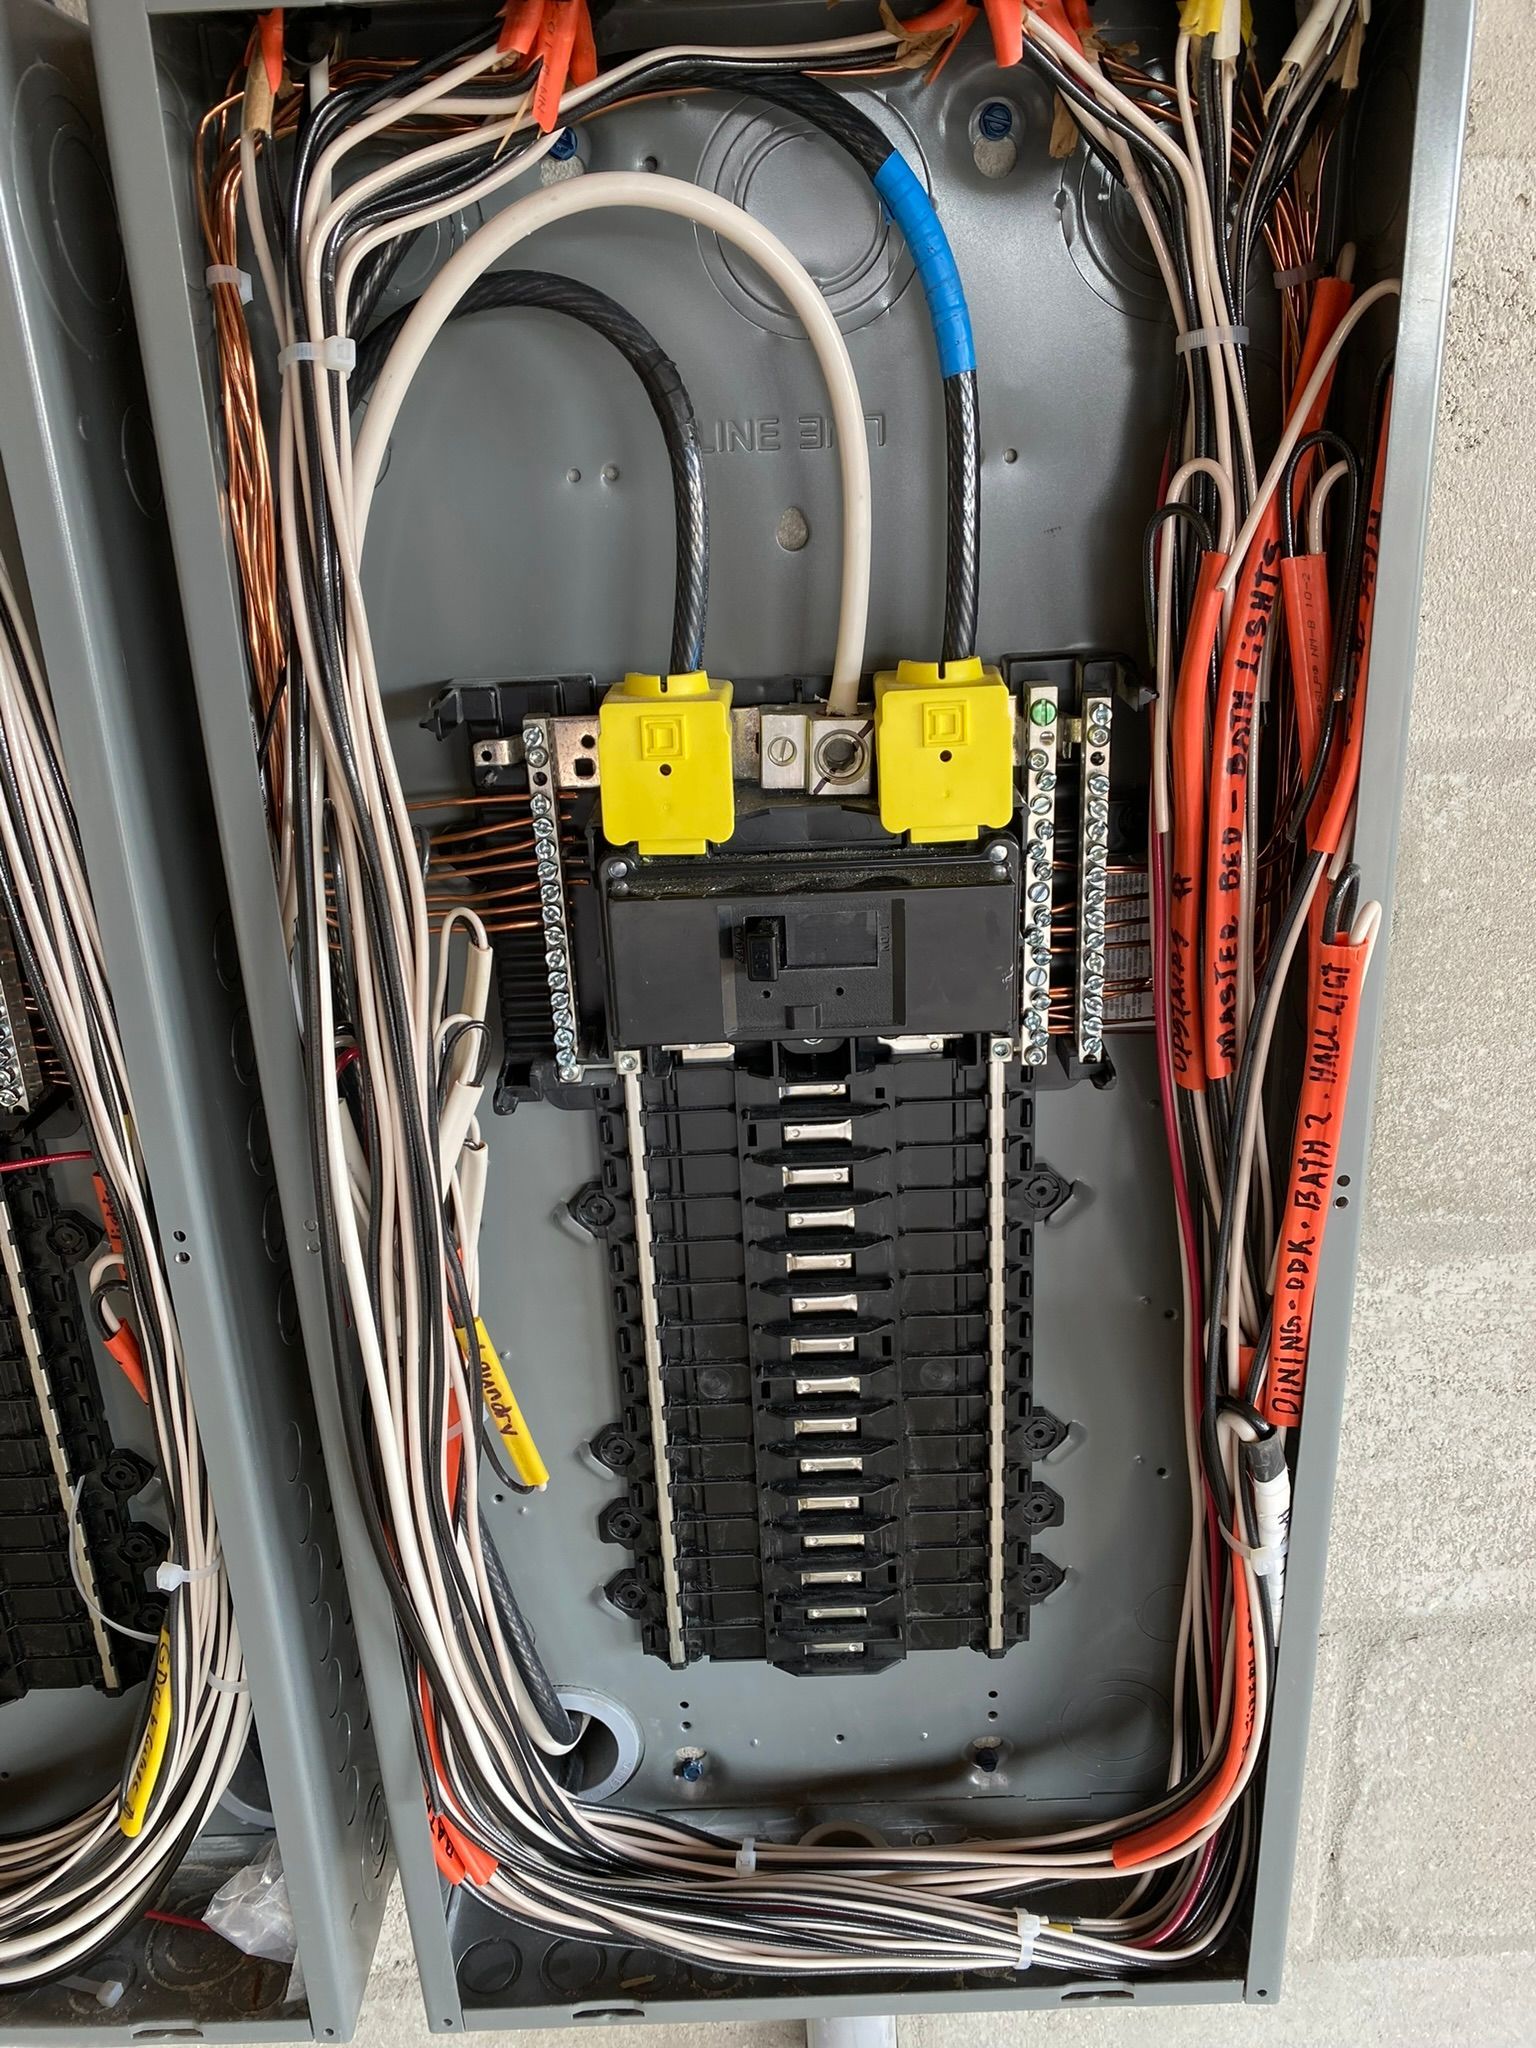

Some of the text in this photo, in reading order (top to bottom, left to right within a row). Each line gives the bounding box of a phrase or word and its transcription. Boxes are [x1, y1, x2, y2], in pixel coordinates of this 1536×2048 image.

[700, 416, 782, 454] LINE
[1301, 572, 1313, 608] 10-2
[1226, 690, 1254, 777] BATH
[1219, 827, 1243, 892] BED
[1213, 915, 1239, 1064] MASTER
[1309, 1025, 1340, 1084] HALL
[1304, 1111, 1333, 1129] 2
[1294, 1139, 1332, 1210] BATH
[479, 1344, 518, 1436] aundry
